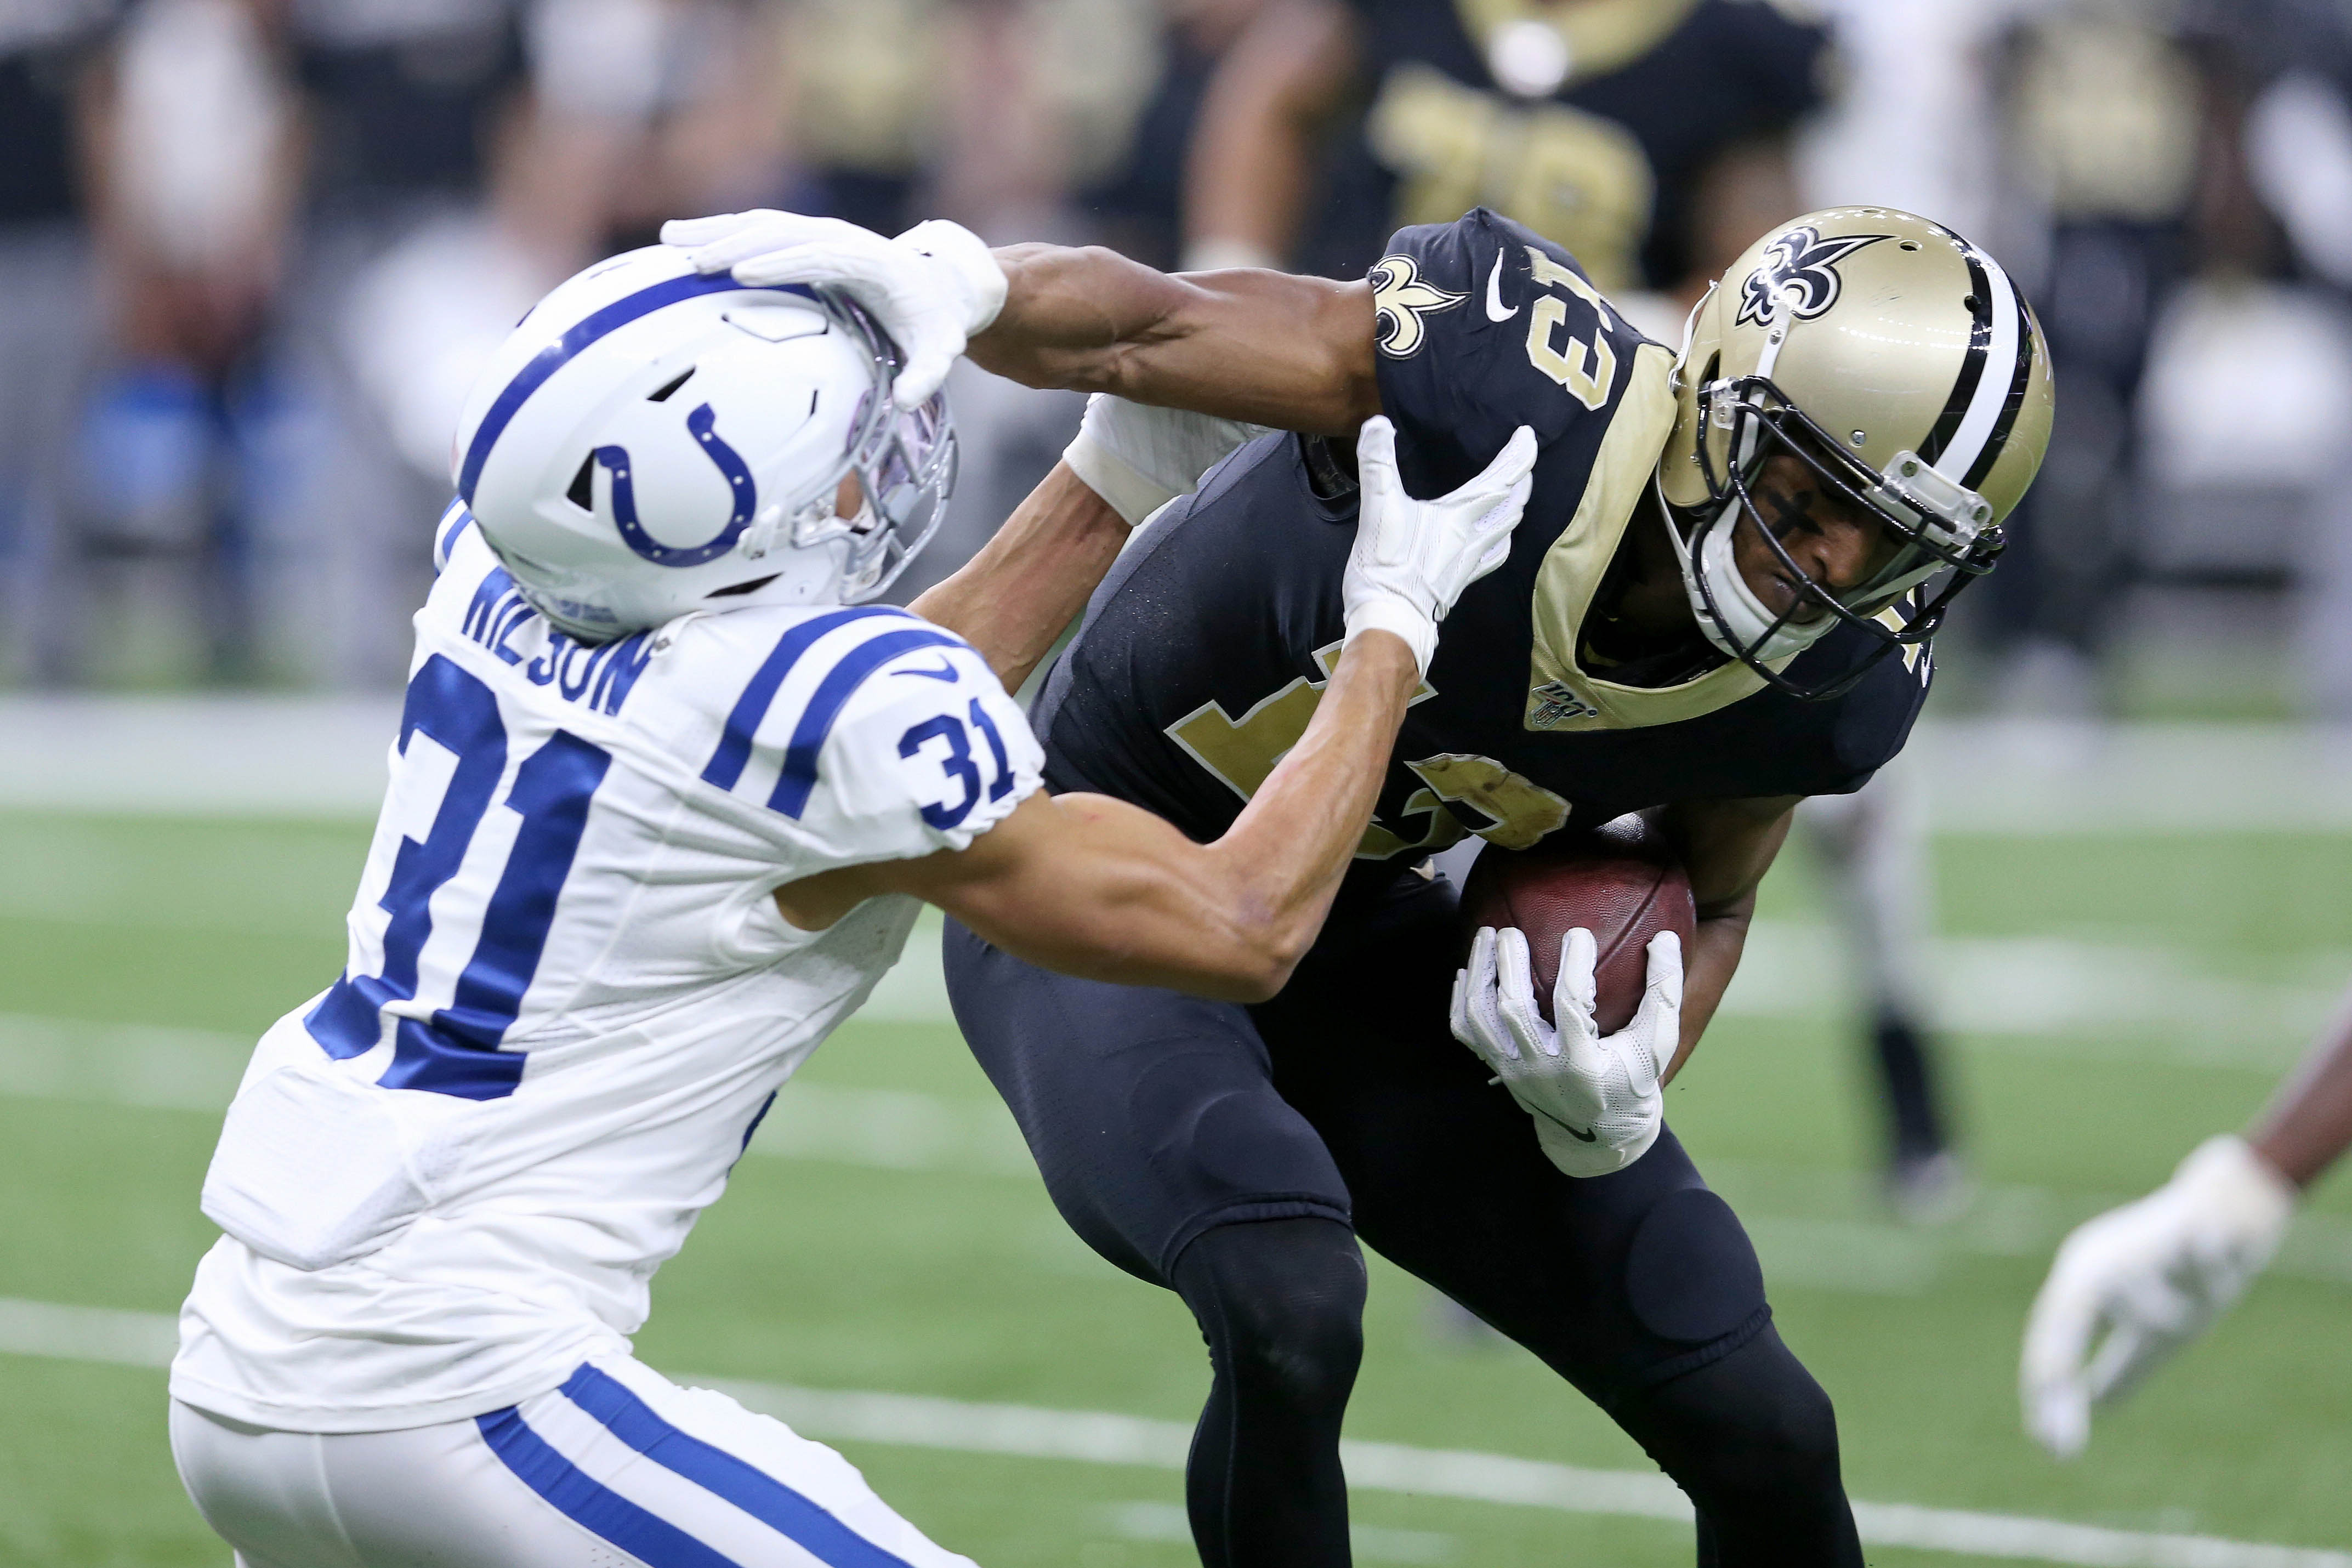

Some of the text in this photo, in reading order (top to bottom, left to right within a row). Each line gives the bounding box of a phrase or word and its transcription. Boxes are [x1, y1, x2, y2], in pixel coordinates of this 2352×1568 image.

[1524, 245, 1617, 412] 13
[897, 696, 1016, 831] 31
[303, 652, 613, 1101] 31
